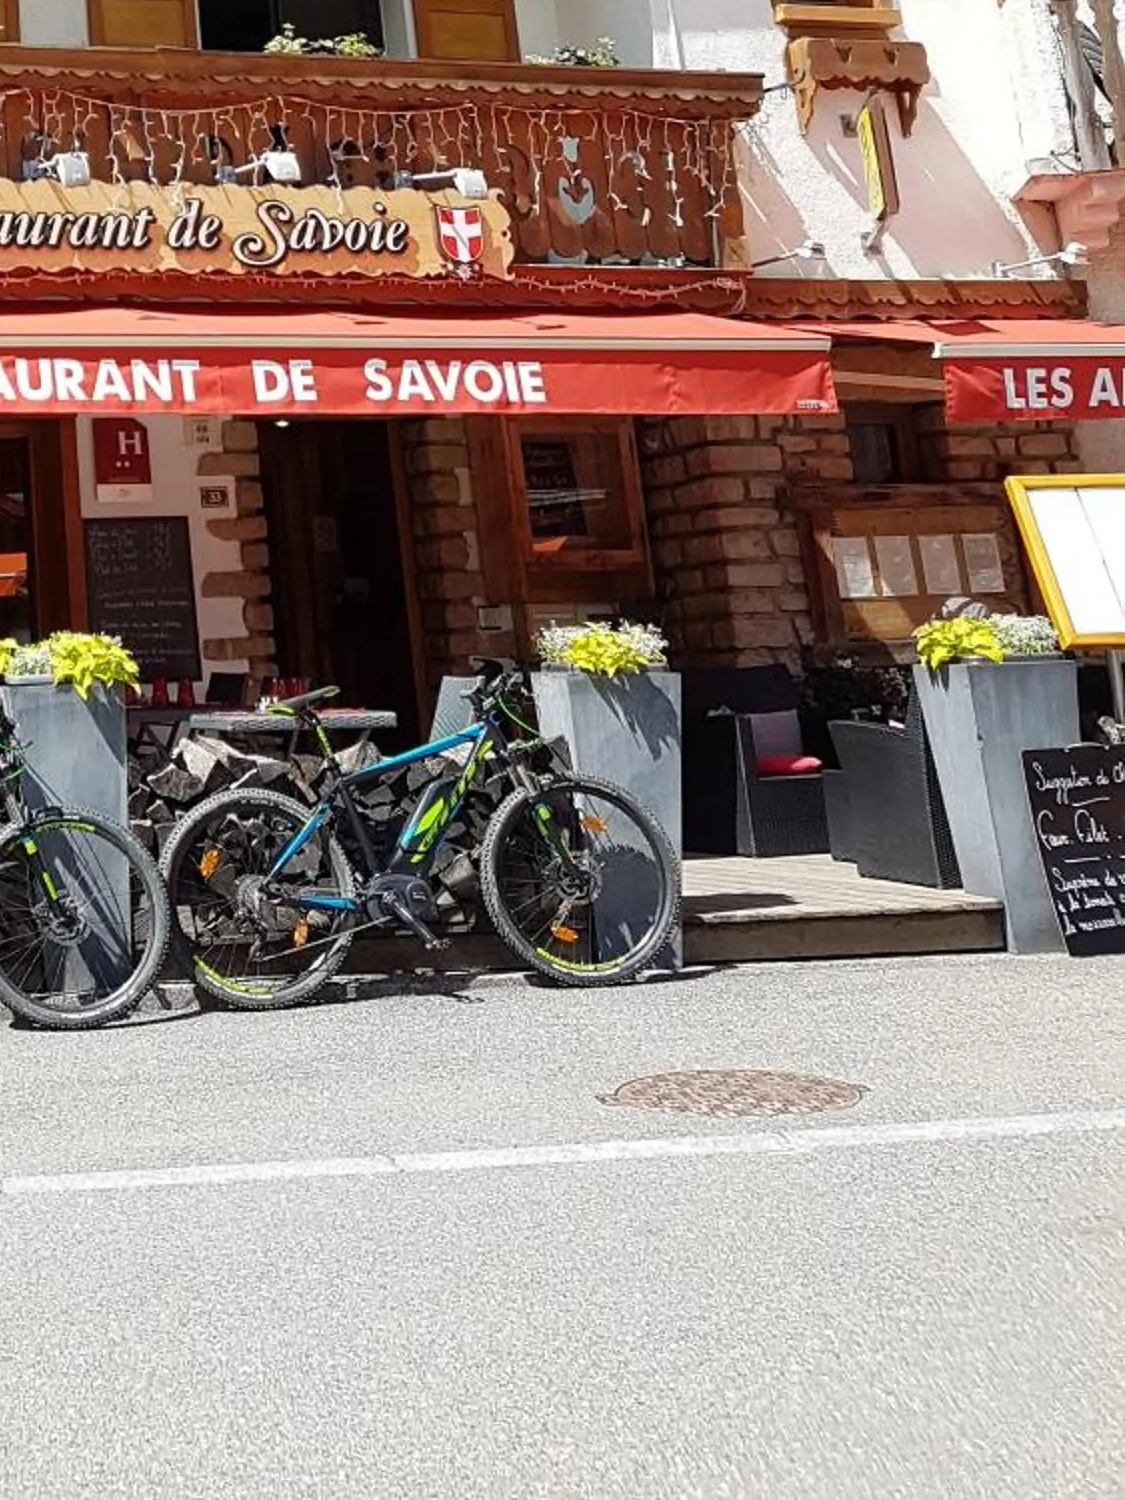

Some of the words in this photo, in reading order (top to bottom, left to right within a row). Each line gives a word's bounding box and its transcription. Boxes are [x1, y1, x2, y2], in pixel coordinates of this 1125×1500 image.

[168, 198, 222, 249] de
[233, 199, 408, 266] Savoie
[251, 359, 318, 403] DE
[363, 359, 547, 404] SAVOIE
[1003, 367, 1074, 409] LES
[1088, 367, 1125, 408] A
[118, 431, 144, 455] H
